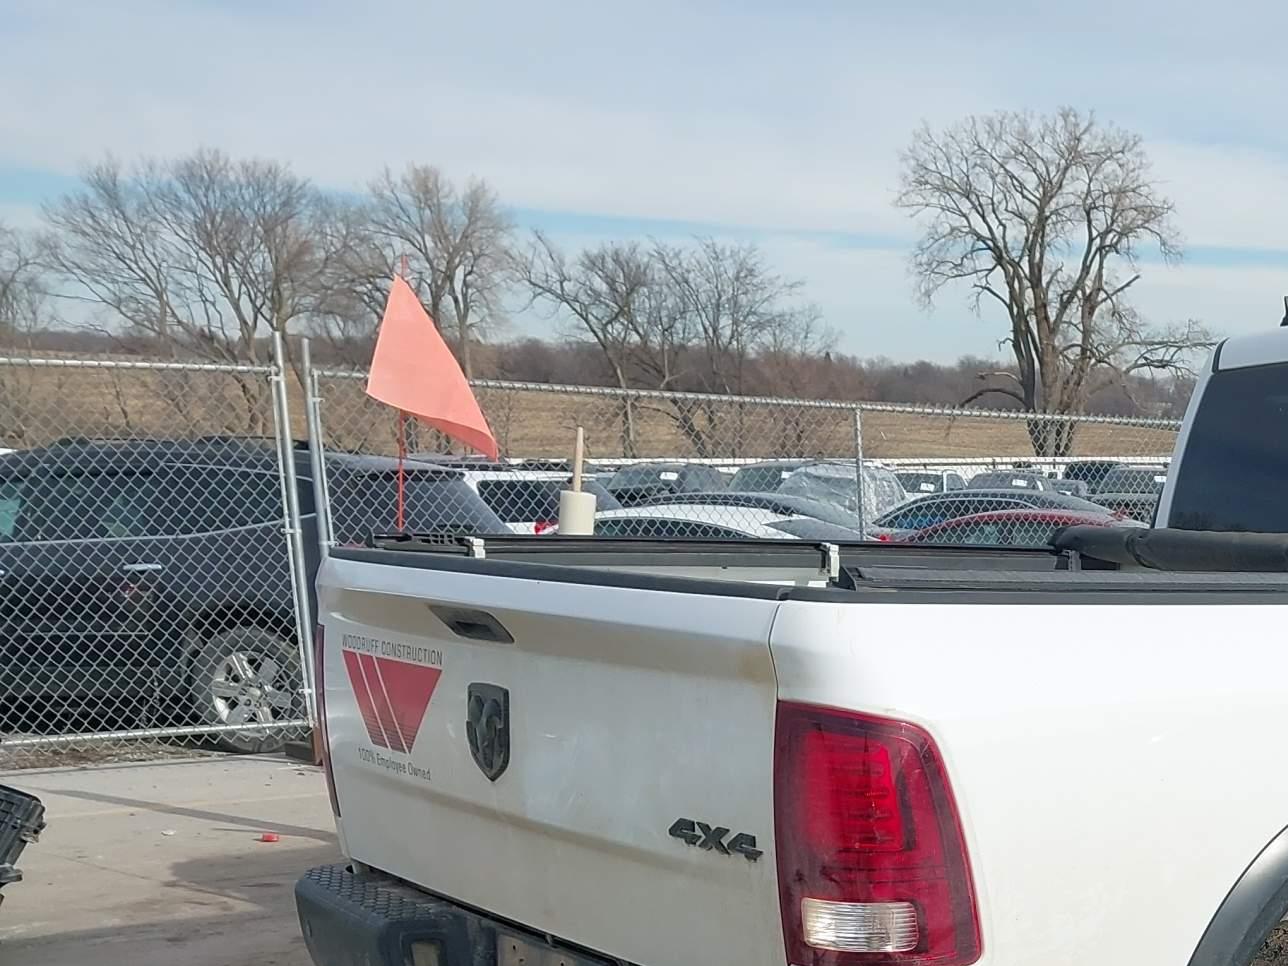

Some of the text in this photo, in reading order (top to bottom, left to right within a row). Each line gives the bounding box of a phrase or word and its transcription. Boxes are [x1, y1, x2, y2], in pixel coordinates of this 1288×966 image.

[342, 634, 443, 666] WOODRUFF CONSTRUCTION
[358, 747, 432, 781] 100% Employee Owned
